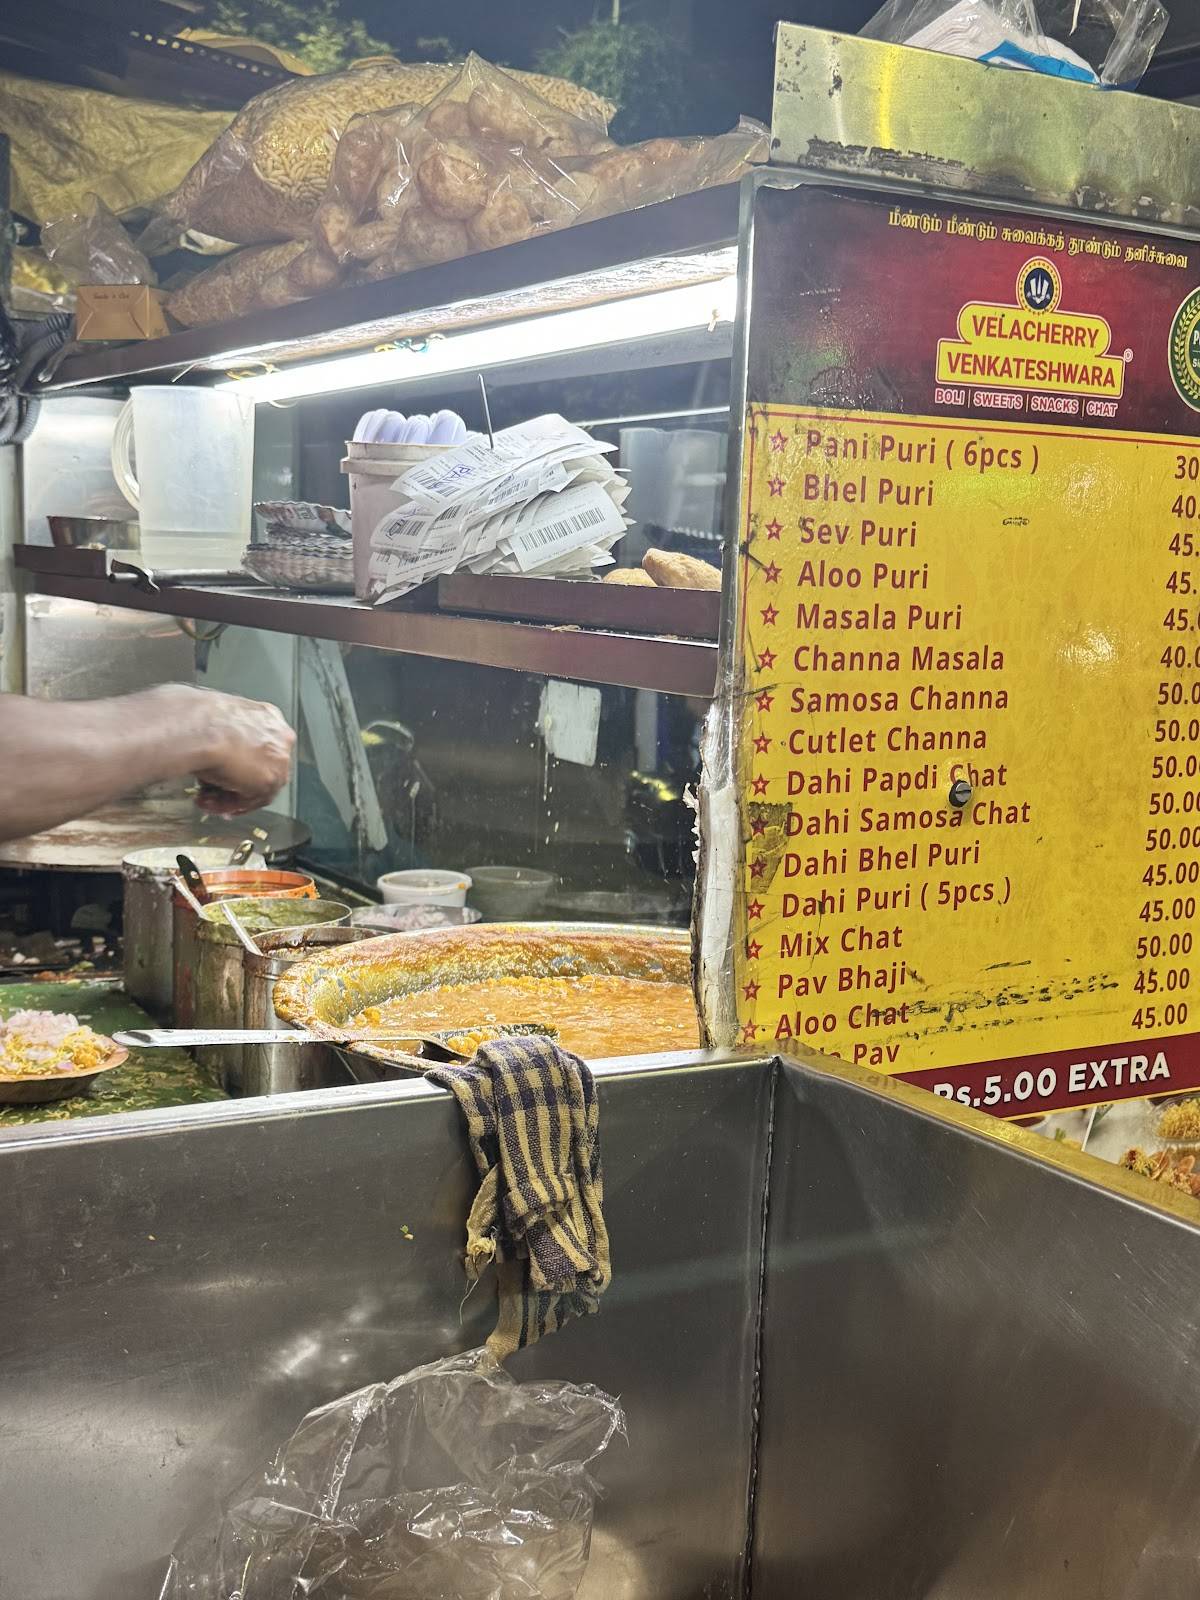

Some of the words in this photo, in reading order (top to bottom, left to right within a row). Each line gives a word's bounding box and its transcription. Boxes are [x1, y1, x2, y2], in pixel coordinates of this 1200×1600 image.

[888, 209, 942, 233] மீண்டும்
[946, 214, 998, 241] மீண்டும்
[1001, 228, 1065, 253] சுவைக்கத்
[1068, 236, 1122, 261] தூண்டும்
[972, 315, 1099, 348] VELACHERRY
[947, 351, 1115, 387] VENKATESHWARA
[935, 388, 965, 405] BOLI
[973, 391, 1023, 409] SWEETS
[1031, 396, 1079, 414] SNACKS
[1086, 401, 1118, 417] CHAT
[806, 430, 868, 459] Pani
[880, 435, 936, 464] Puri
[804, 474, 866, 503] Bhel
[878, 478, 933, 506] Puri
[800, 518, 850, 545] Sev
[861, 520, 916, 547] Puri
[797, 560, 862, 588] Aloo
[873, 562, 928, 590] Puri
[796, 602, 896, 630] Masala
[907, 604, 962, 631] Puri
[1163, 608, 1200, 631] 45.
[794, 645, 900, 672] Channa
[912, 645, 1005, 672] Masala
[790, 688, 899, 713] Samosa
[910, 684, 1009, 711] Channa
[788, 729, 876, 756] Cutlet
[887, 726, 987, 752] Channa
[787, 769, 851, 796] Dahi
[862, 765, 937, 797] Papdi
[950, 763, 1007, 787] Chat
[1152, 755, 1200, 779] 50.0
[786, 808, 850, 838] Dahi
[860, 808, 963, 833] Samosa
[973, 801, 1030, 825] Chat
[783, 848, 848, 879] Dahi
[858, 846, 917, 873] Bhel
[928, 840, 980, 868] Puri
[1146, 827, 1200, 851] 50.00
[781, 889, 846, 920] Dahi
[856, 884, 911, 912] Puri
[1142, 861, 1199, 886] 45.00
[780, 931, 829, 960] Mix
[840, 925, 902, 953] Chat
[1139, 897, 1195, 922] 45.00
[777, 970, 828, 999] Pav
[838, 960, 907, 994] Bhaji
[1136, 933, 1192, 959] 50.00
[775, 1011, 837, 1041] Aloo
[848, 1002, 910, 1028] Chat
[1134, 968, 1190, 994] 45.00
[853, 1043, 900, 1066] Pav
[1132, 1003, 1188, 1029] 45.00
[1068, 1051, 1170, 1092] EXTRA
